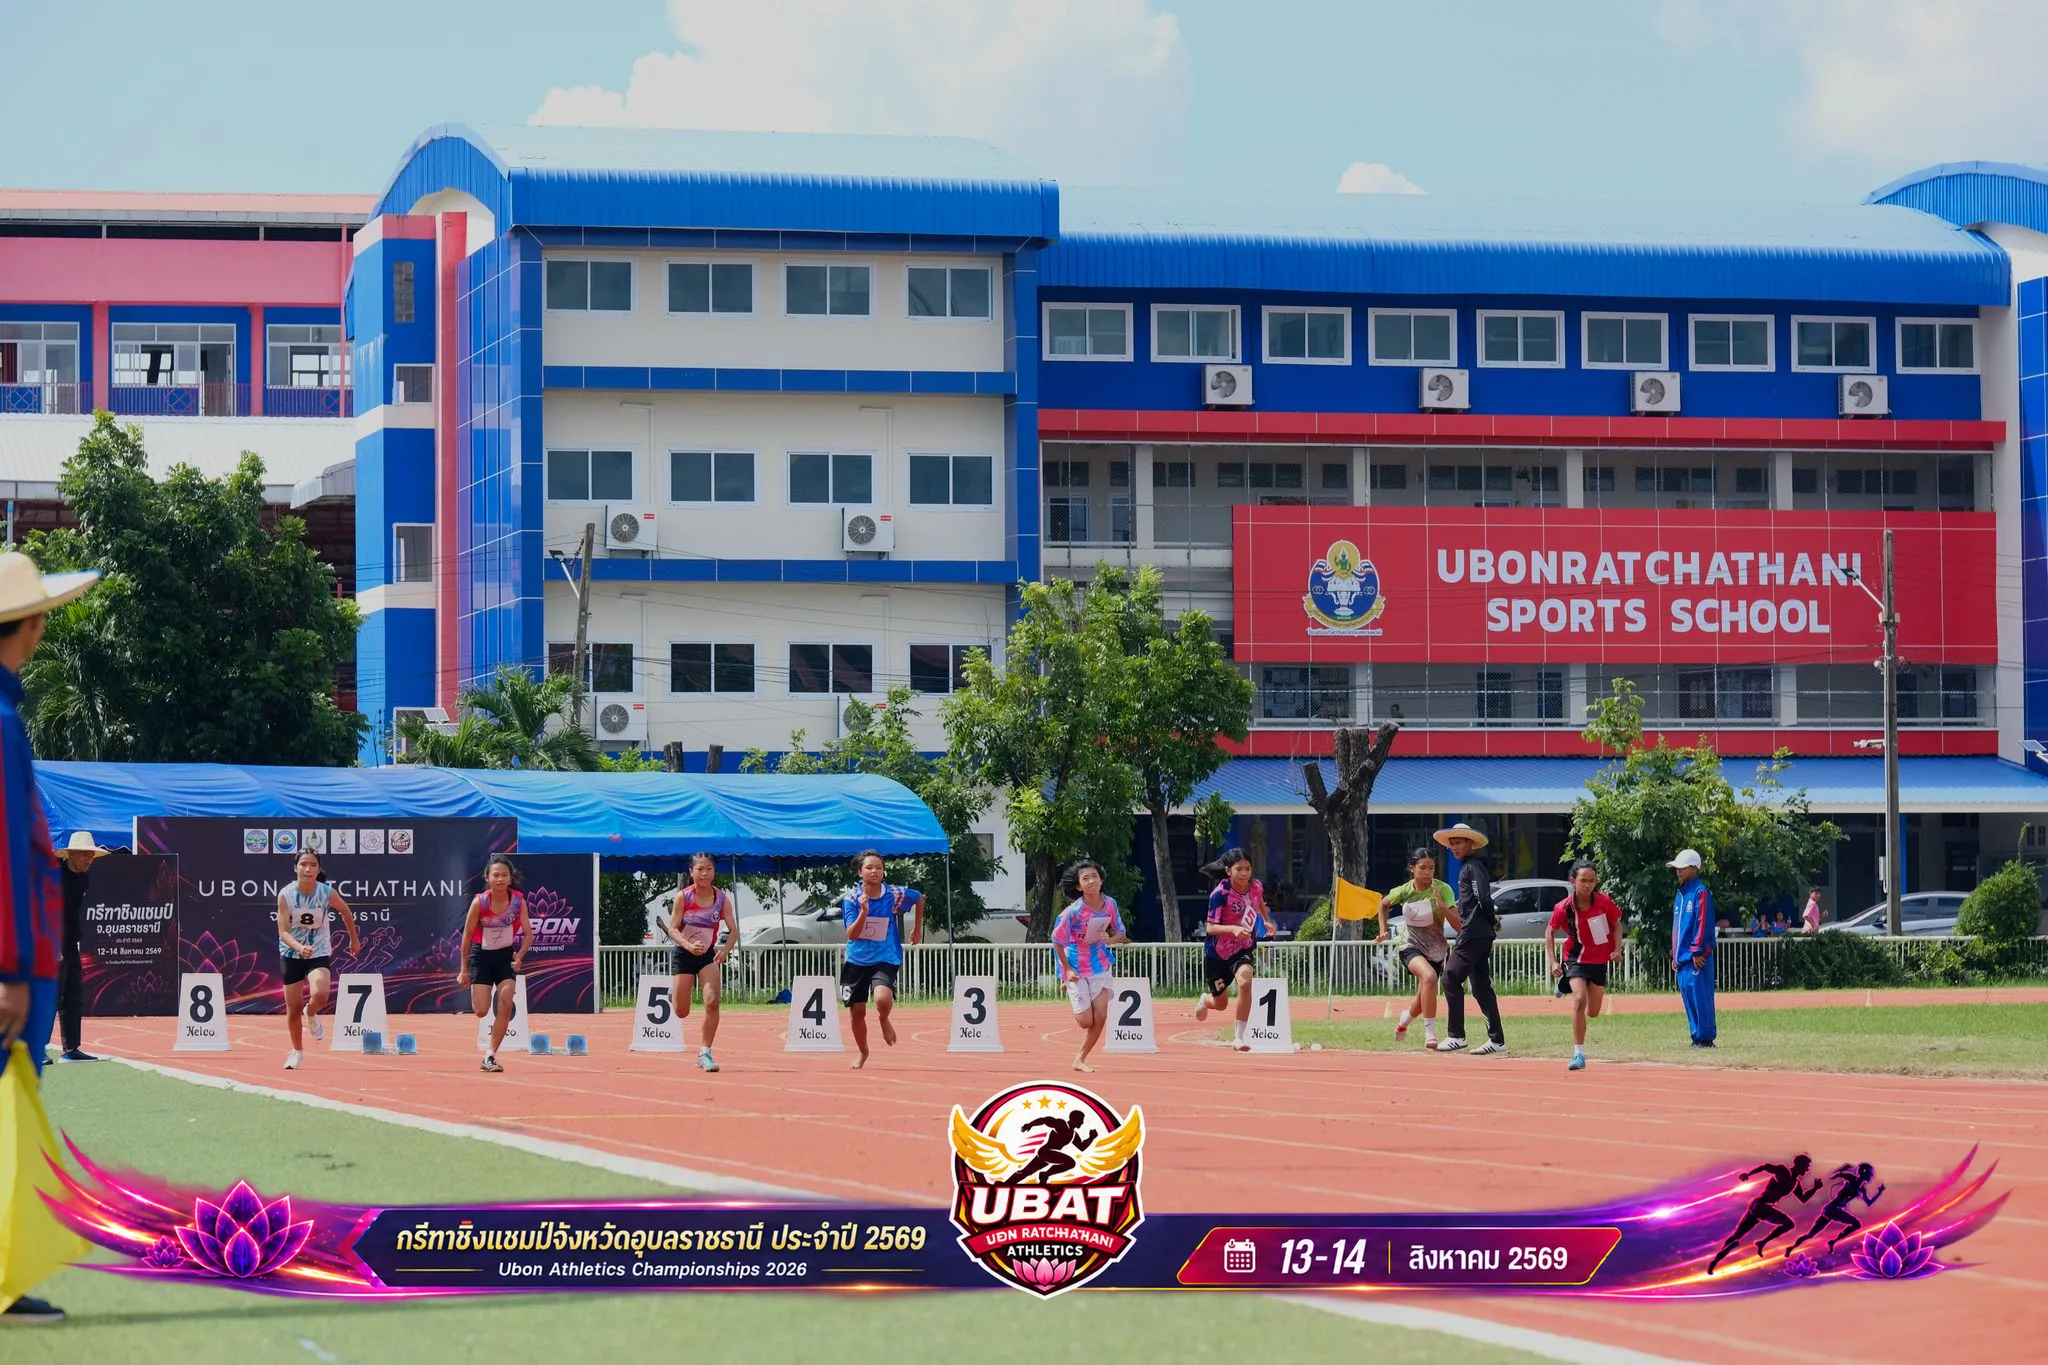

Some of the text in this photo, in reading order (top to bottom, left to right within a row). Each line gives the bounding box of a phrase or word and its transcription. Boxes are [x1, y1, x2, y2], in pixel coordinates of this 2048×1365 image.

[1437, 549, 1861, 586] UBONRATCHATHANI
[1487, 598, 1830, 633] SPORTS SCHOOL
[198, 880, 278, 897] UBON
[300, 912, 315, 925] 8
[516, 918, 581, 934] BON
[864, 921, 879, 938] 5
[97, 947, 118, 955] 12-14
[145, 947, 162, 955] 2569
[190, 984, 214, 1023] 8
[347, 985, 372, 1023] 7
[646, 986, 671, 1025] 5
[802, 988, 826, 1026] 4
[963, 987, 987, 1025] 3
[1118, 990, 1142, 1027] 2
[1259, 988, 1278, 1027] 1
